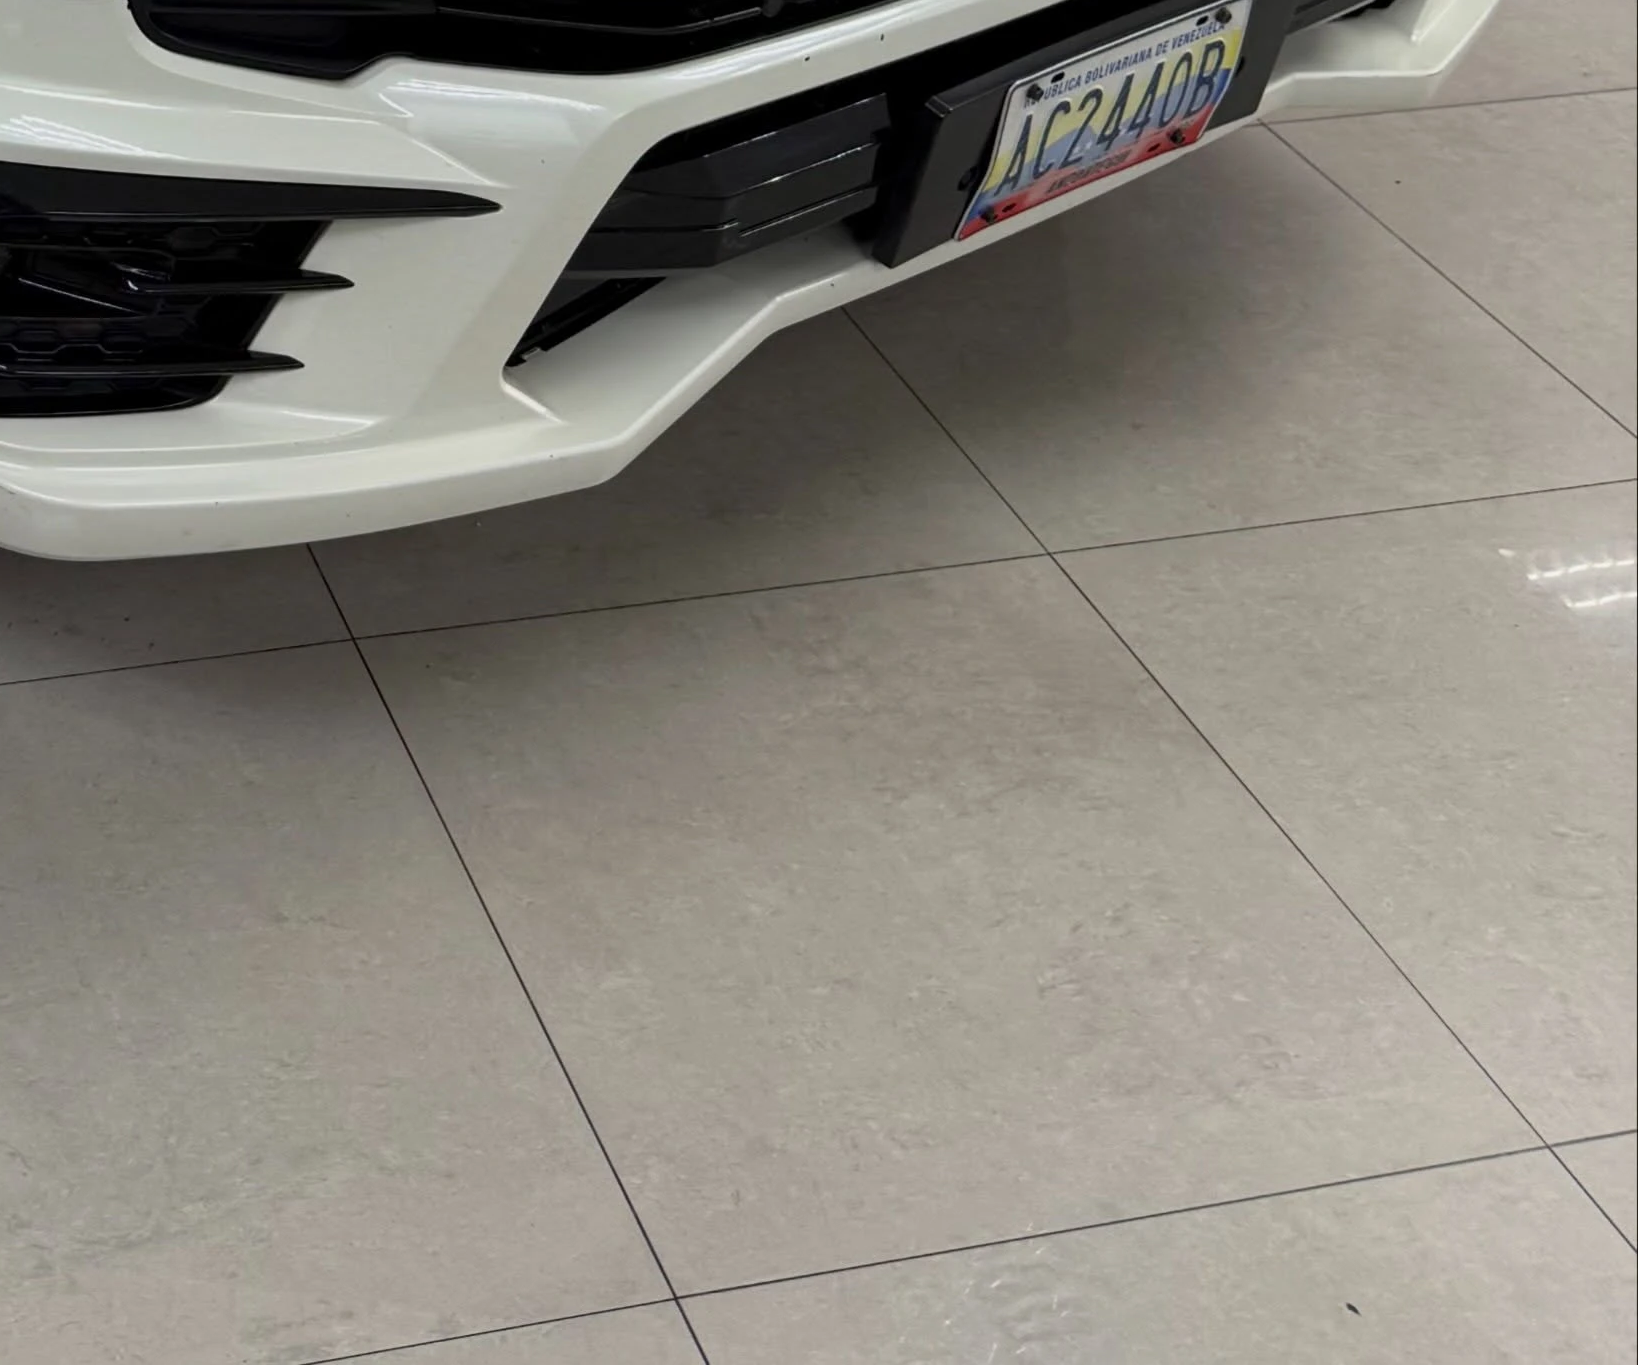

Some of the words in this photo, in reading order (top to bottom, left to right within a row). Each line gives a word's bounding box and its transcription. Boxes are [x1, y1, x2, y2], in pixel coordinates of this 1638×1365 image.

[1023, 74, 1081, 109] RUBLICA
[1084, 47, 1152, 85] BOLIVARIANA
[1155, 41, 1169, 57] DE
